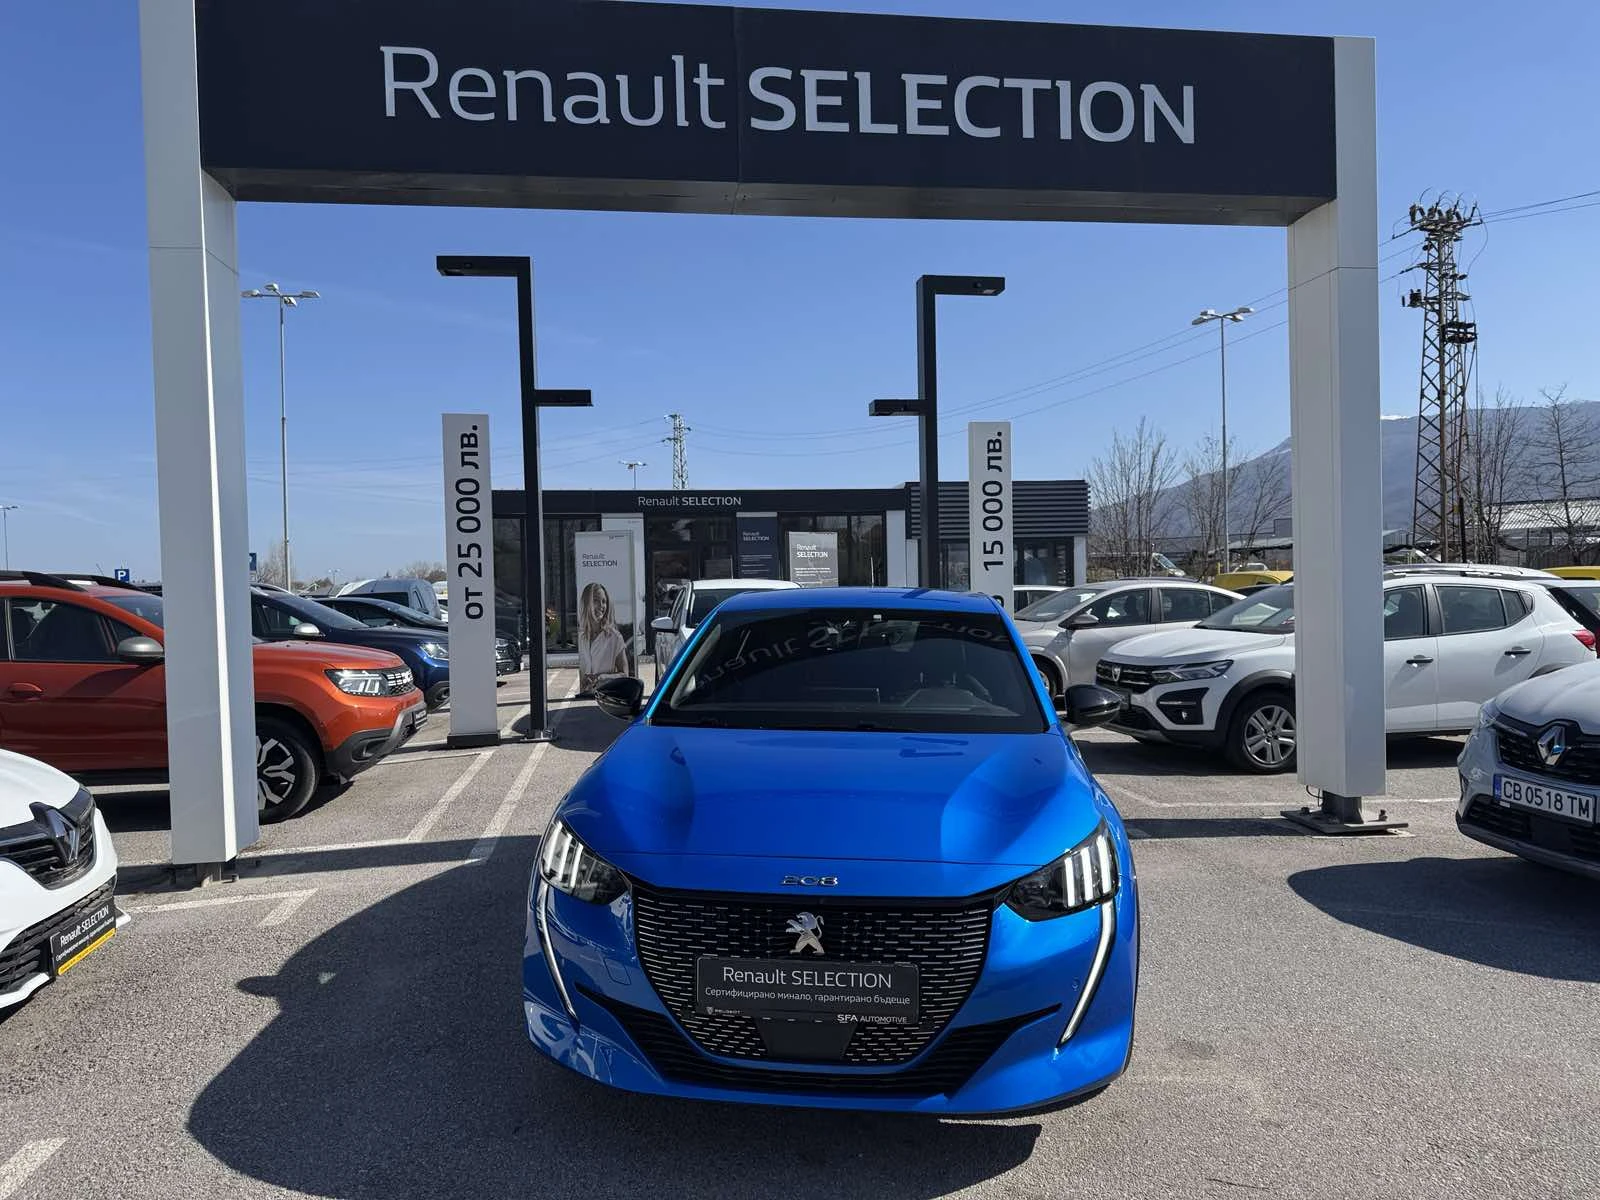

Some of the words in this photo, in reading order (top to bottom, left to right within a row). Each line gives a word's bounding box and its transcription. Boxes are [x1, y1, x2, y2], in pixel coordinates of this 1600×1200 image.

[379, 46, 726, 129] Renault
[749, 66, 1195, 145] SELECTION
[460, 424, 480, 470] лв.
[987, 431, 1003, 472] лв.
[455, 478, 482, 533] 000
[638, 496, 680, 506] Renault
[682, 496, 742, 506] SELECTION
[982, 480, 1004, 532] 000
[457, 543, 483, 578] 25
[582, 560, 618, 568] SELECTION
[983, 540, 1004, 571] 15
[117, 570, 127, 581] P
[465, 587, 484, 620] от
[1503, 781, 1522, 801] CB
[1525, 786, 1563, 811] 0518
[1567, 795, 1590, 818] TM
[60, 924, 82, 948] Renault
[81, 904, 110, 933] SELECTION
[723, 966, 787, 985] Renault
[791, 969, 892, 989] SELECTION
[705, 986, 776, 999] Сертифицирано
[815, 994, 872, 1004] гарантирано
[873, 994, 911, 1005] бъдеще
[837, 1014, 858, 1022] SFA
[860, 1015, 908, 1023] AUTOMOTIVE
